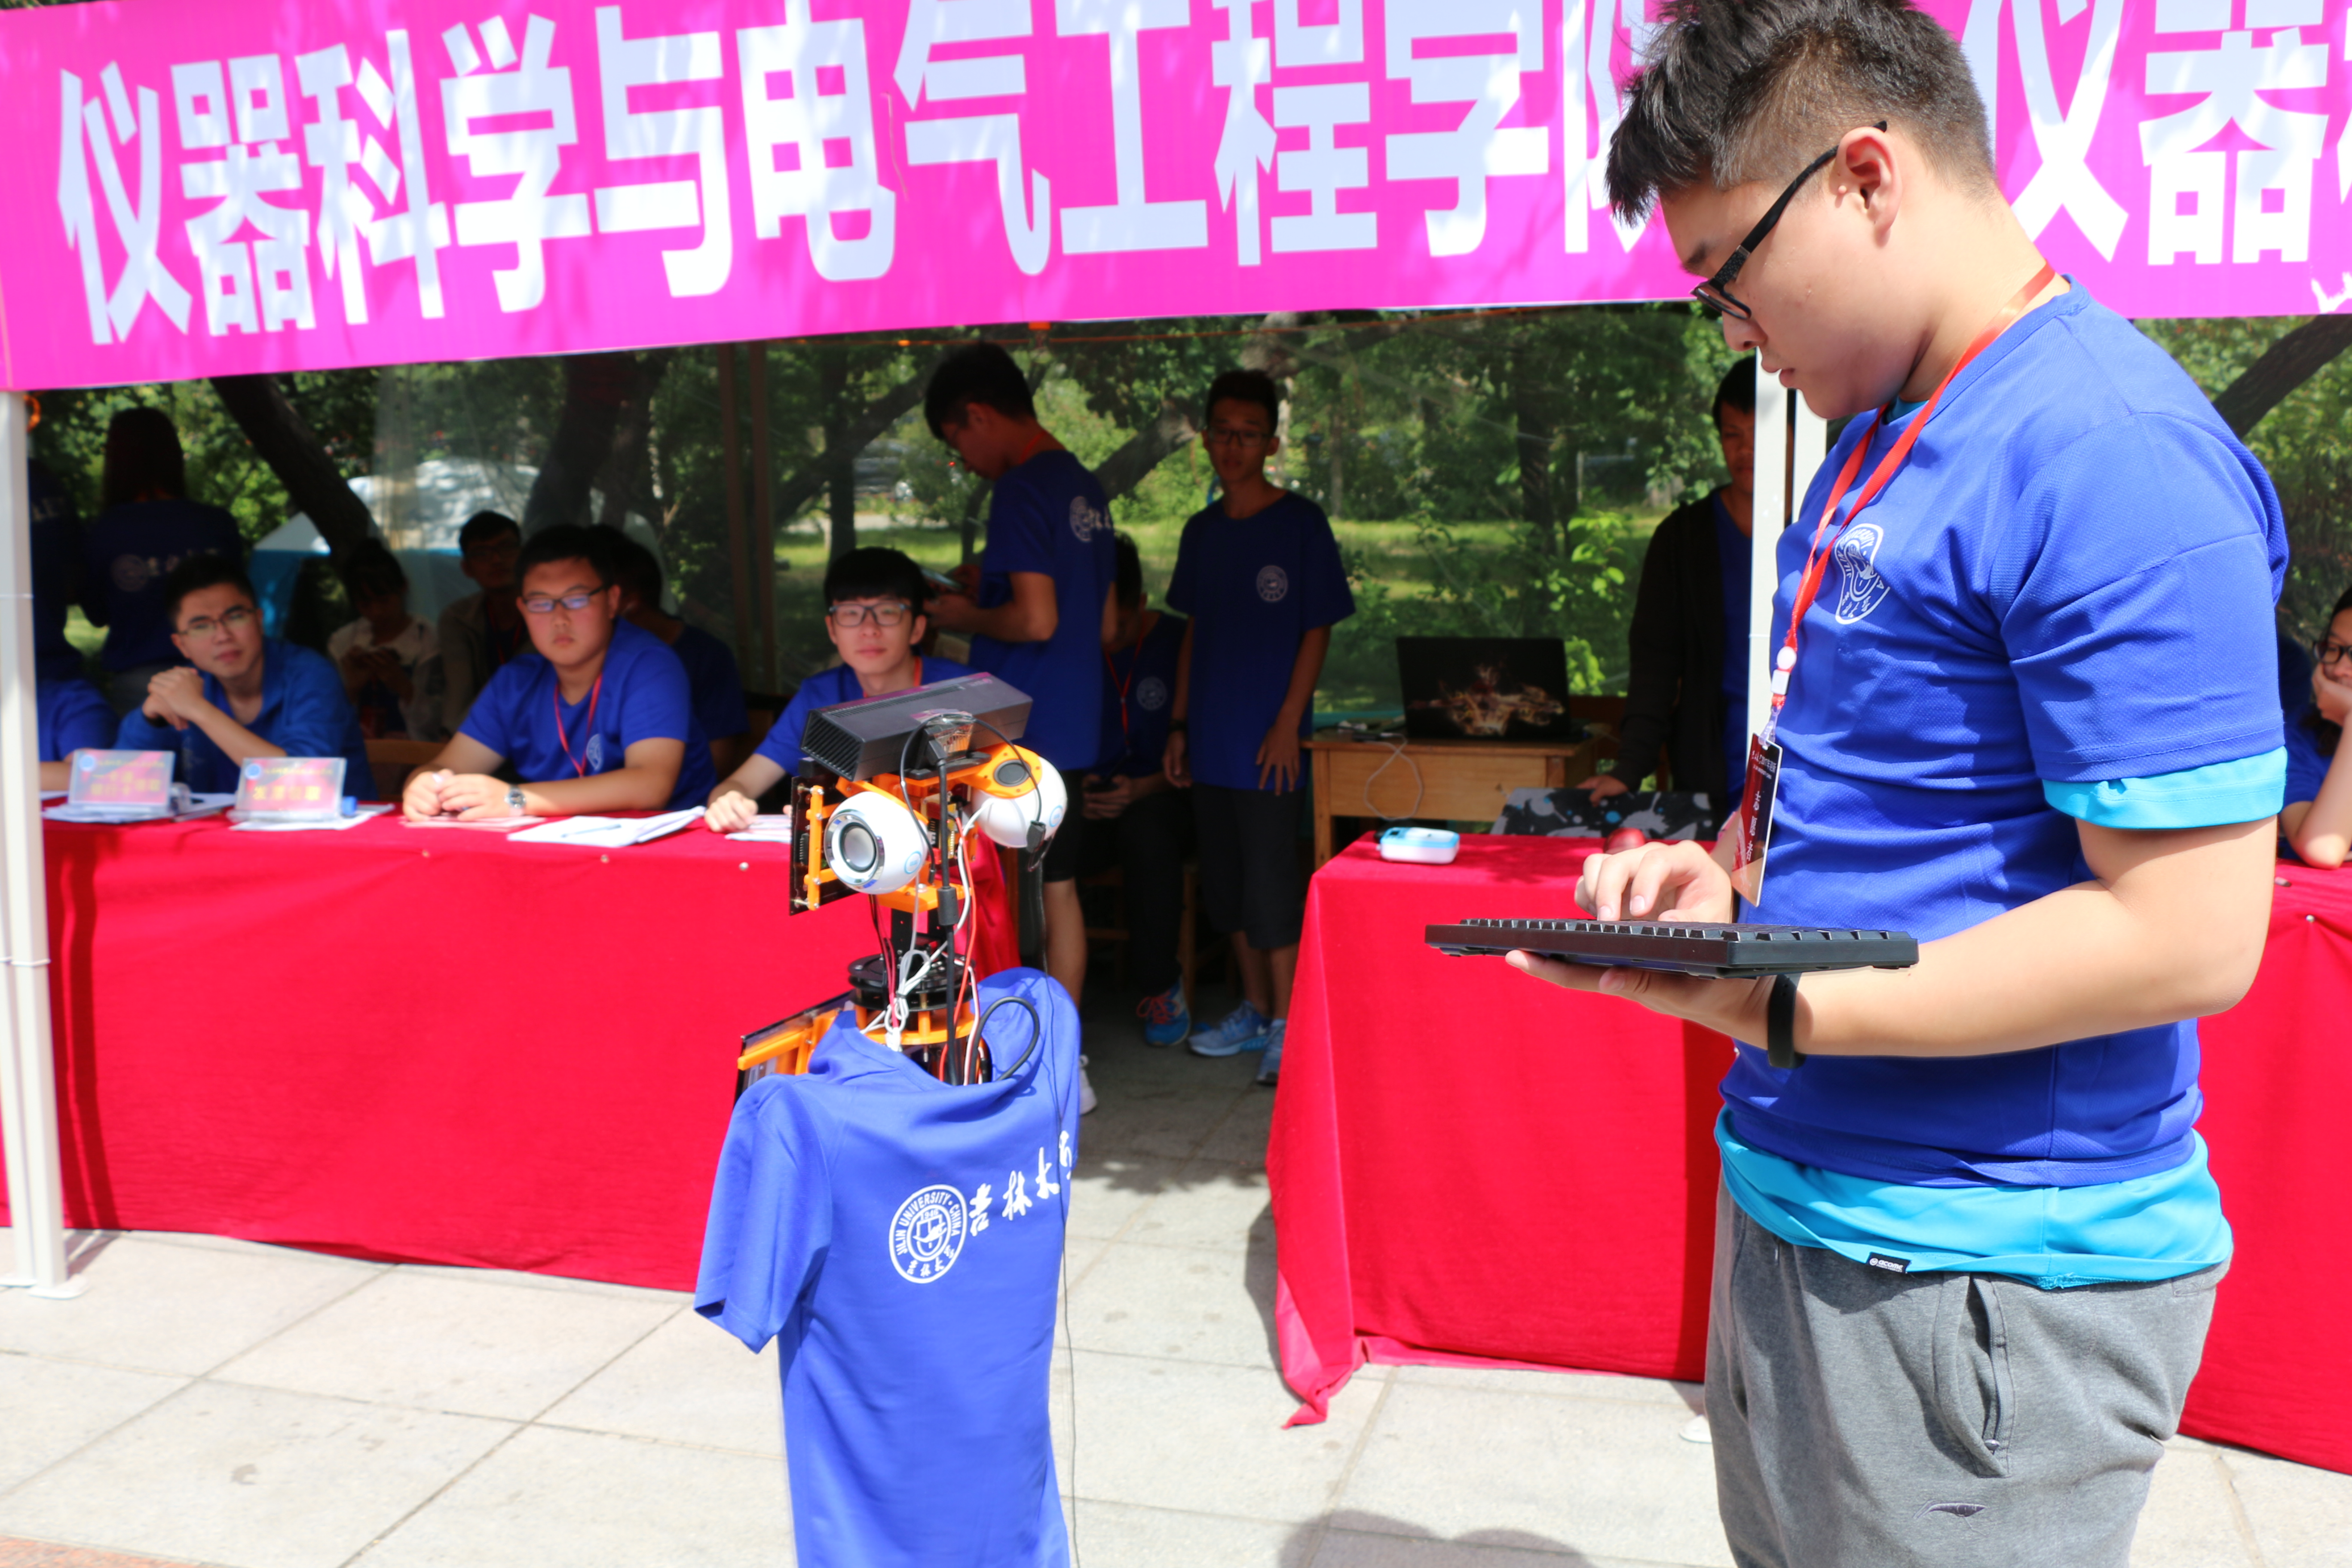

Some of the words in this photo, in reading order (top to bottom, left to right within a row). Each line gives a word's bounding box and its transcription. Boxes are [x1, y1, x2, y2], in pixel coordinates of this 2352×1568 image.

[1960, 0, 2352, 265] 仪器
[898, 1191, 952, 1226] UNIVERSITY
[920, 1208, 939, 1221] 1946
[949, 1204, 962, 1237] CHINA
[895, 1229, 908, 1256] JILIN
[1878, 1259, 1904, 1270] acome
